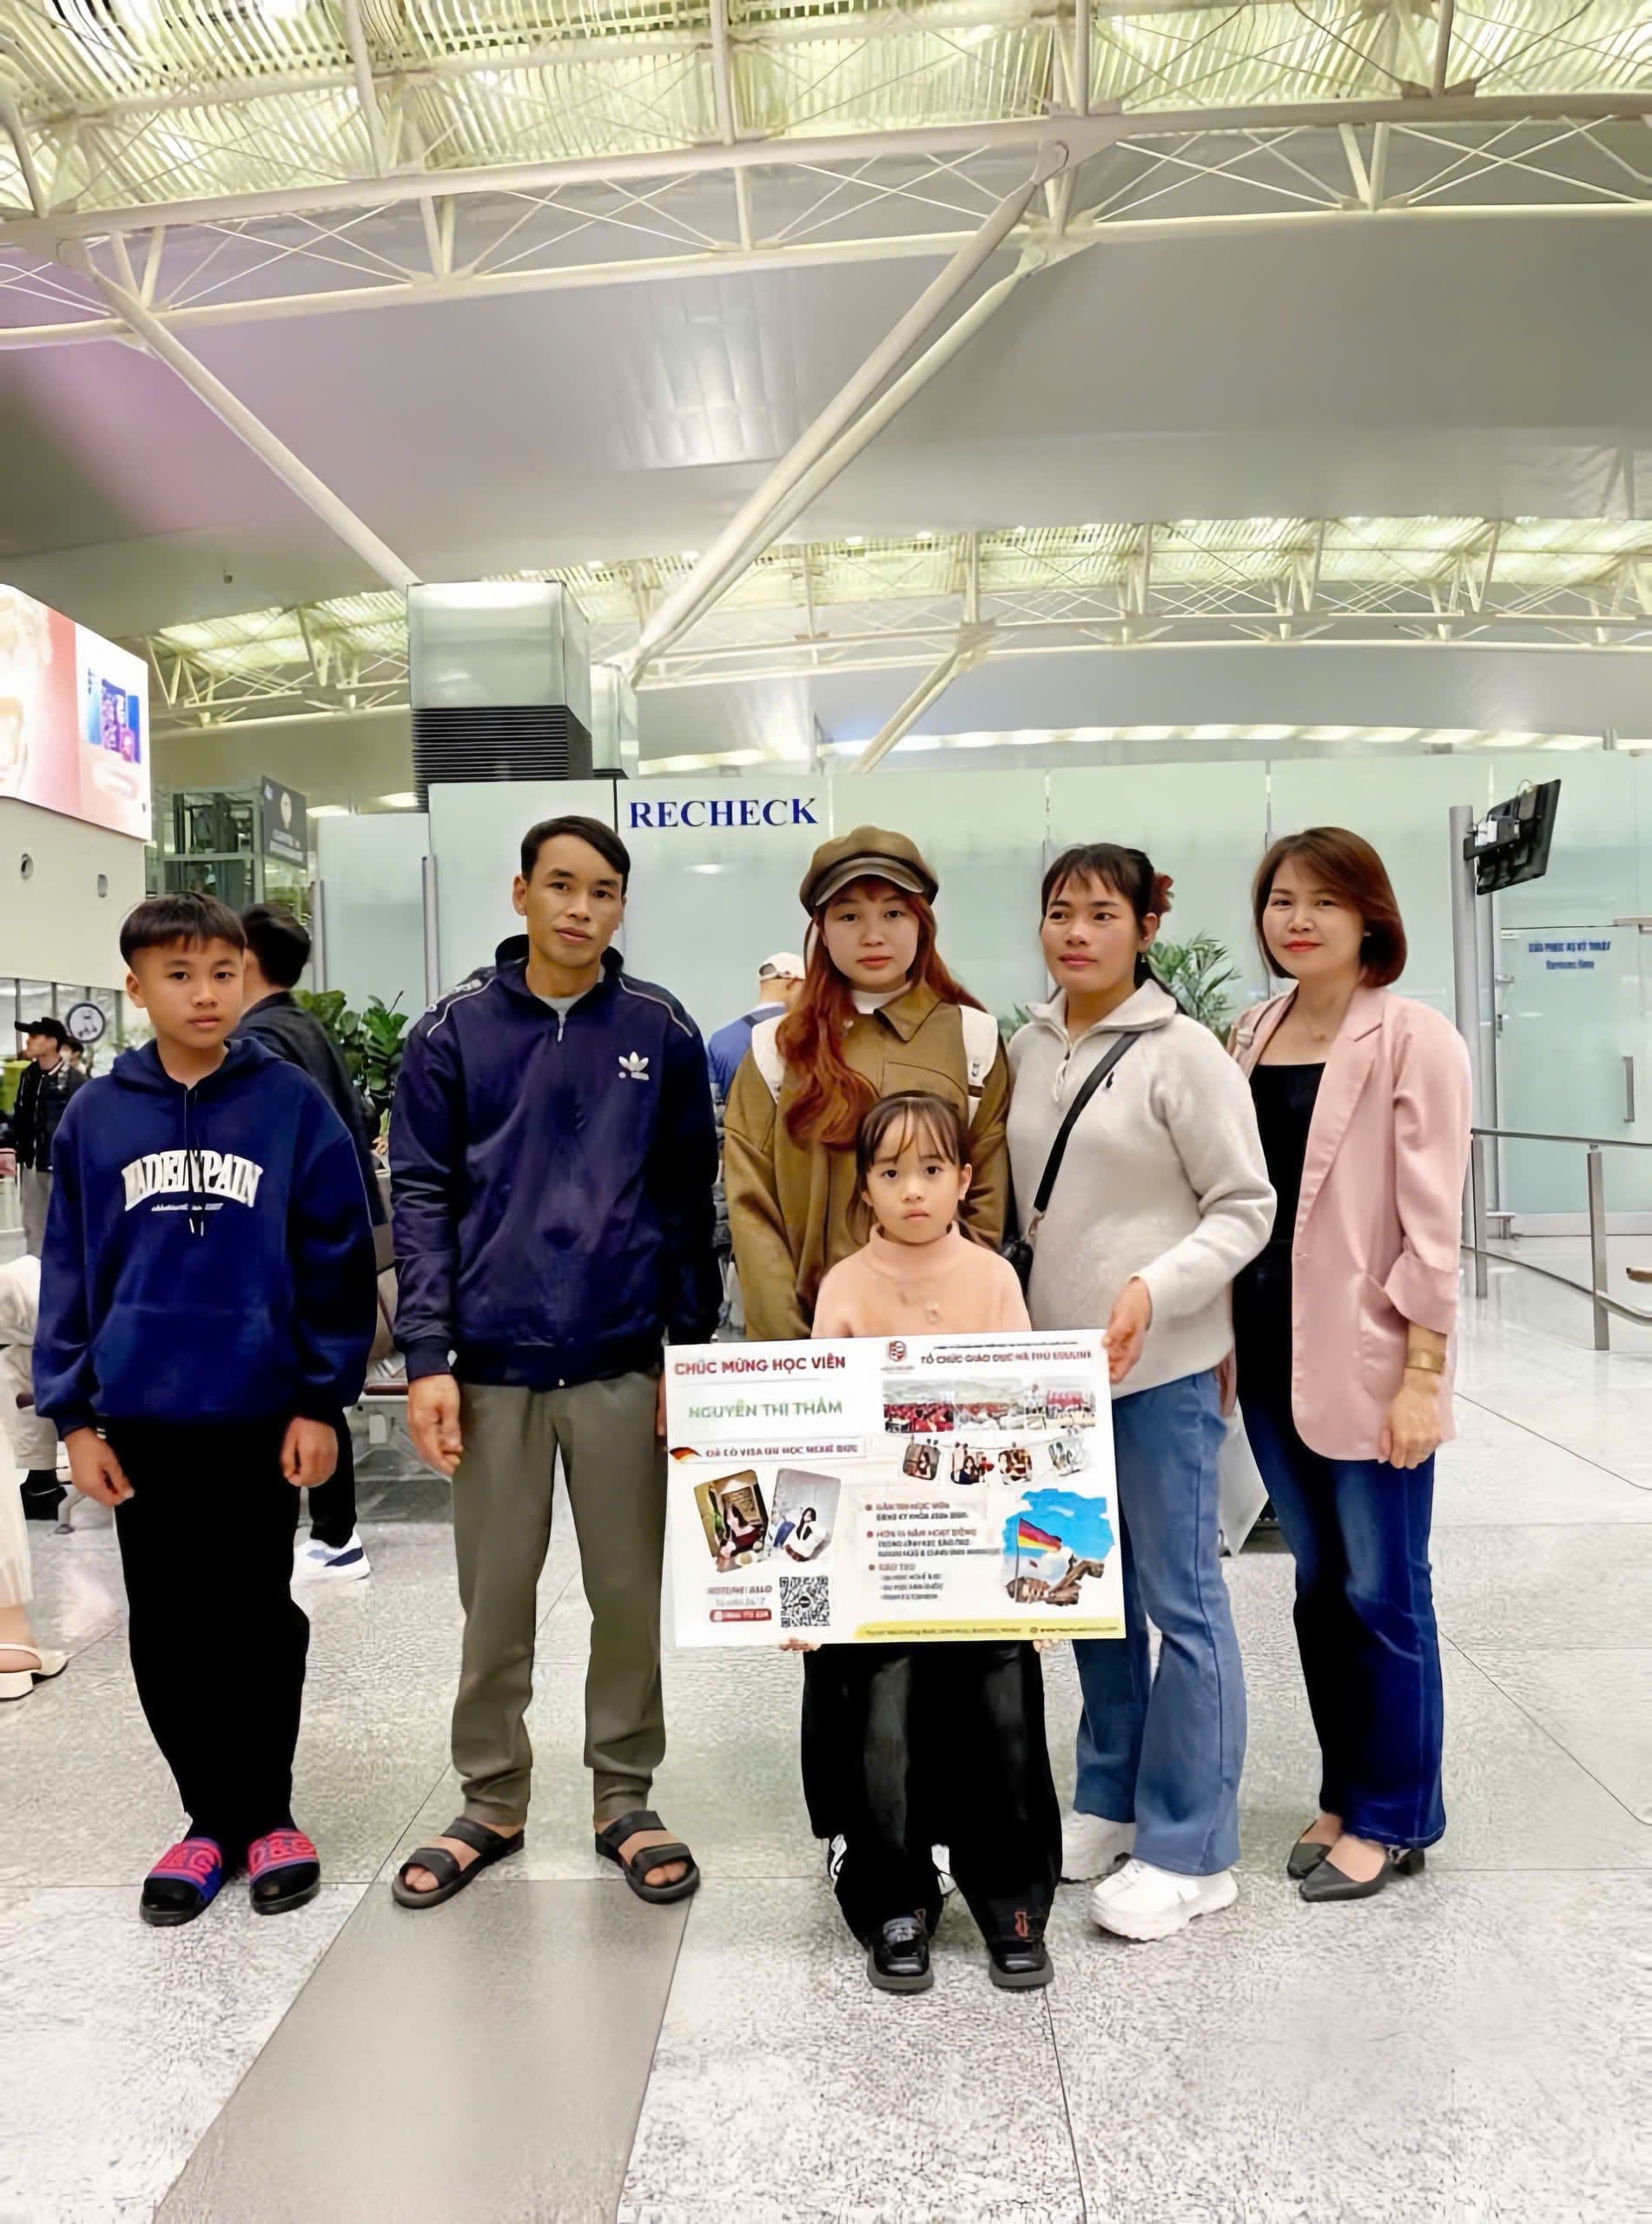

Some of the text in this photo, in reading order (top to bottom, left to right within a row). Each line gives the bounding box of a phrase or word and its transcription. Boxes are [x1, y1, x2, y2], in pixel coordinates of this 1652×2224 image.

[630, 798, 818, 828] RECHECK
[773, 1357, 807, 1374] HỌC
[811, 1353, 846, 1369] VIÊN
